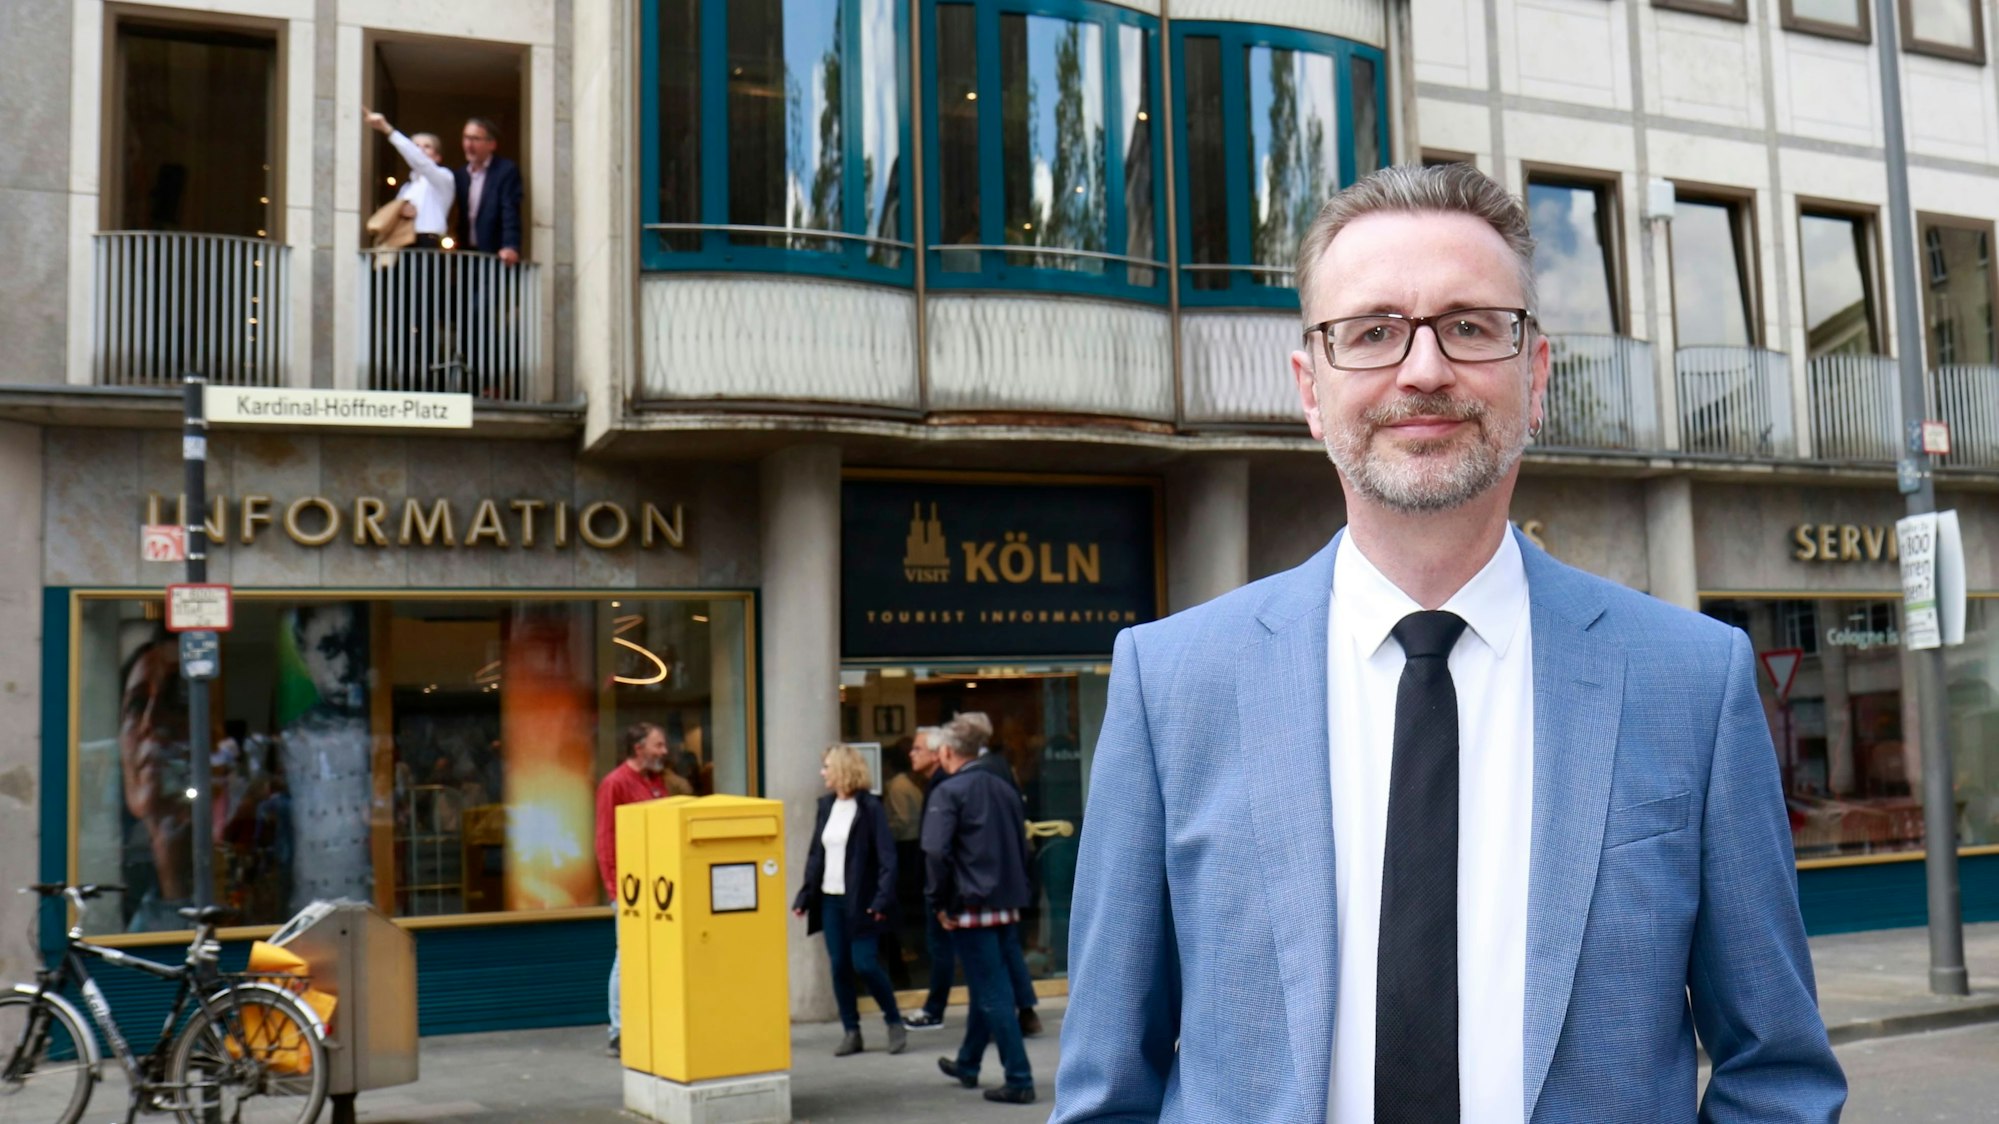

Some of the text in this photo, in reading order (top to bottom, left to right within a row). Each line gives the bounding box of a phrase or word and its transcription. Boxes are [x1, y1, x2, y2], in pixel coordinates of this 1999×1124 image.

[236, 395, 449, 420] Kardinal-Höffner-Platz
[146, 494, 686, 549] INFORMATION
[904, 531, 1101, 584] VISIT KÖLN
[1795, 523, 1898, 561] SERVI
[867, 610, 1136, 623] TOURIST INFORMATION
[1826, 627, 1885, 650] Cologne
